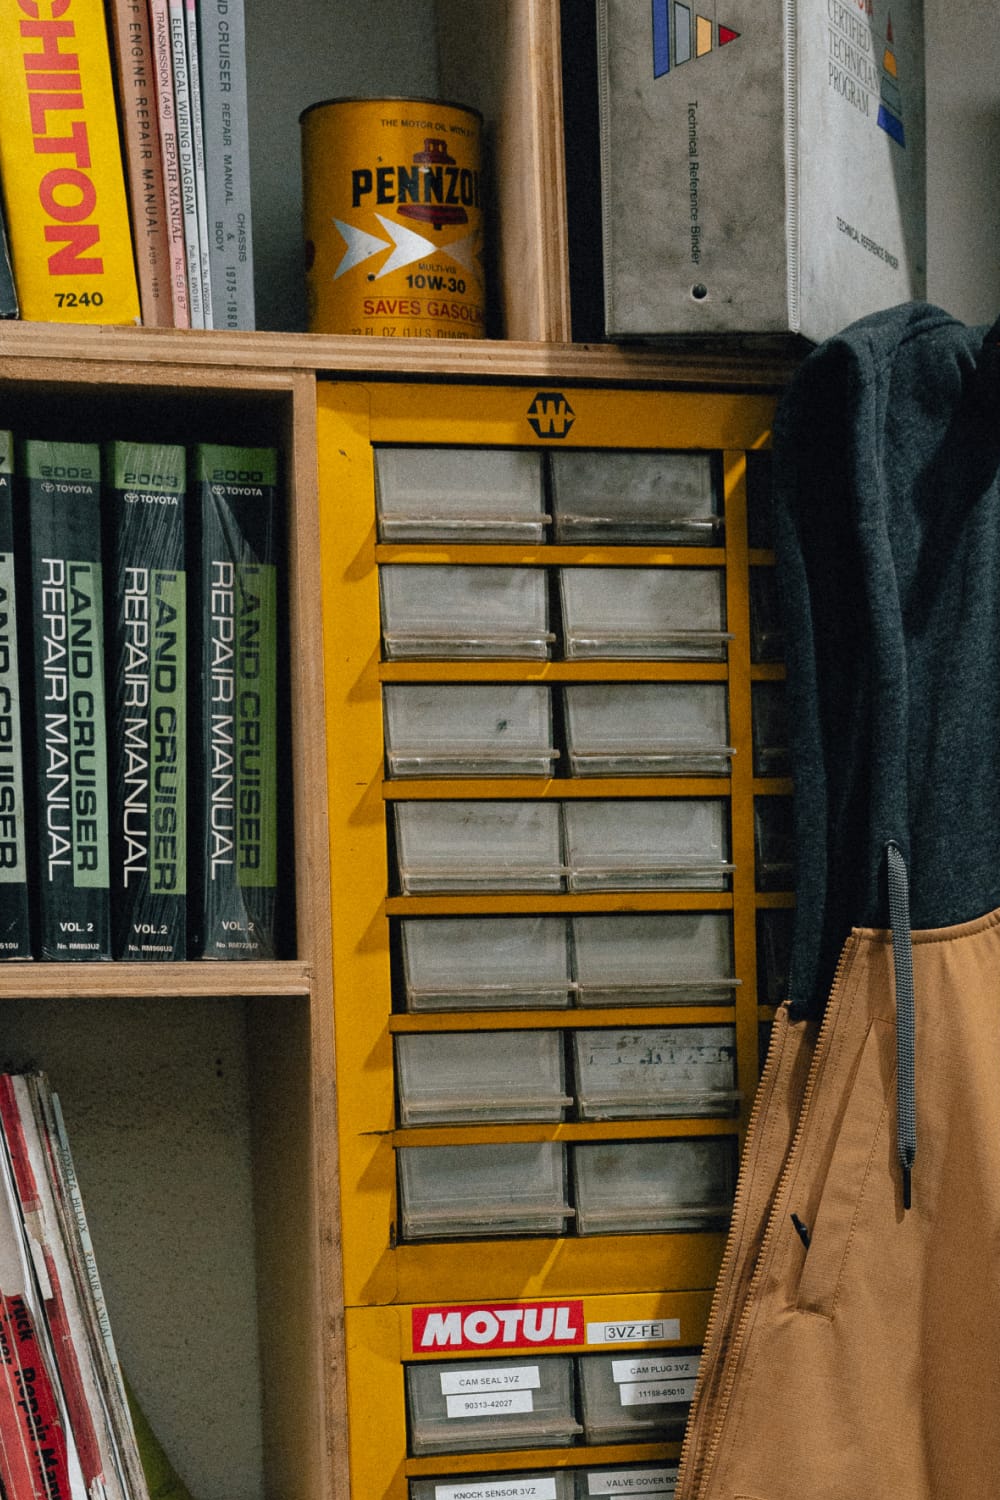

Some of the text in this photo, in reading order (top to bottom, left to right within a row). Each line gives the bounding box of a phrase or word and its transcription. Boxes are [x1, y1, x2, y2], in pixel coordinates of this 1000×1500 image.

[129, 23, 146, 88] ENGINE
[218, 21, 231, 93] CRUISER
[136, 97, 152, 159] REPAIR
[155, 11, 183, 243] TRANSMISSION MANUAL
[173, 18, 195, 215] ELECTRICAL WIRING DIAGRAM
[142, 169, 159, 237] MANUAL
[688, 100, 701, 265] Technical Reference Binder
[54, 291, 104, 309] 7240
[363, 300, 421, 316] SAVES
[405, 274, 466, 294] 10W-30
[56, 484, 93, 494] TOYOTA
[139, 493, 179, 506] TOYOTA
[226, 486, 263, 497] TOYOTA
[41, 557, 72, 883] REPAIR MANUAL
[67, 565, 99, 872] LAND CRUISER
[123, 567, 149, 889] REPAIR MANUAL
[154, 573, 178, 892] LAND CRUISER
[210, 560, 235, 881] REPAIR MANUAL
[237, 562, 261, 872] LAND CRUISER
[421, 1307, 577, 1347] MOTUL
[608, 1325, 662, 1339] 3VZ-FE
[458, 1375, 520, 1387] CAM SEAL 3VZ
[630, 1364, 673, 1375] CAM PLUG
[14, 1367, 47, 1443] Repair
[453, 1488, 519, 1500] KNOCK SENSOR
[606, 1476, 663, 1488] VALVE COVER
